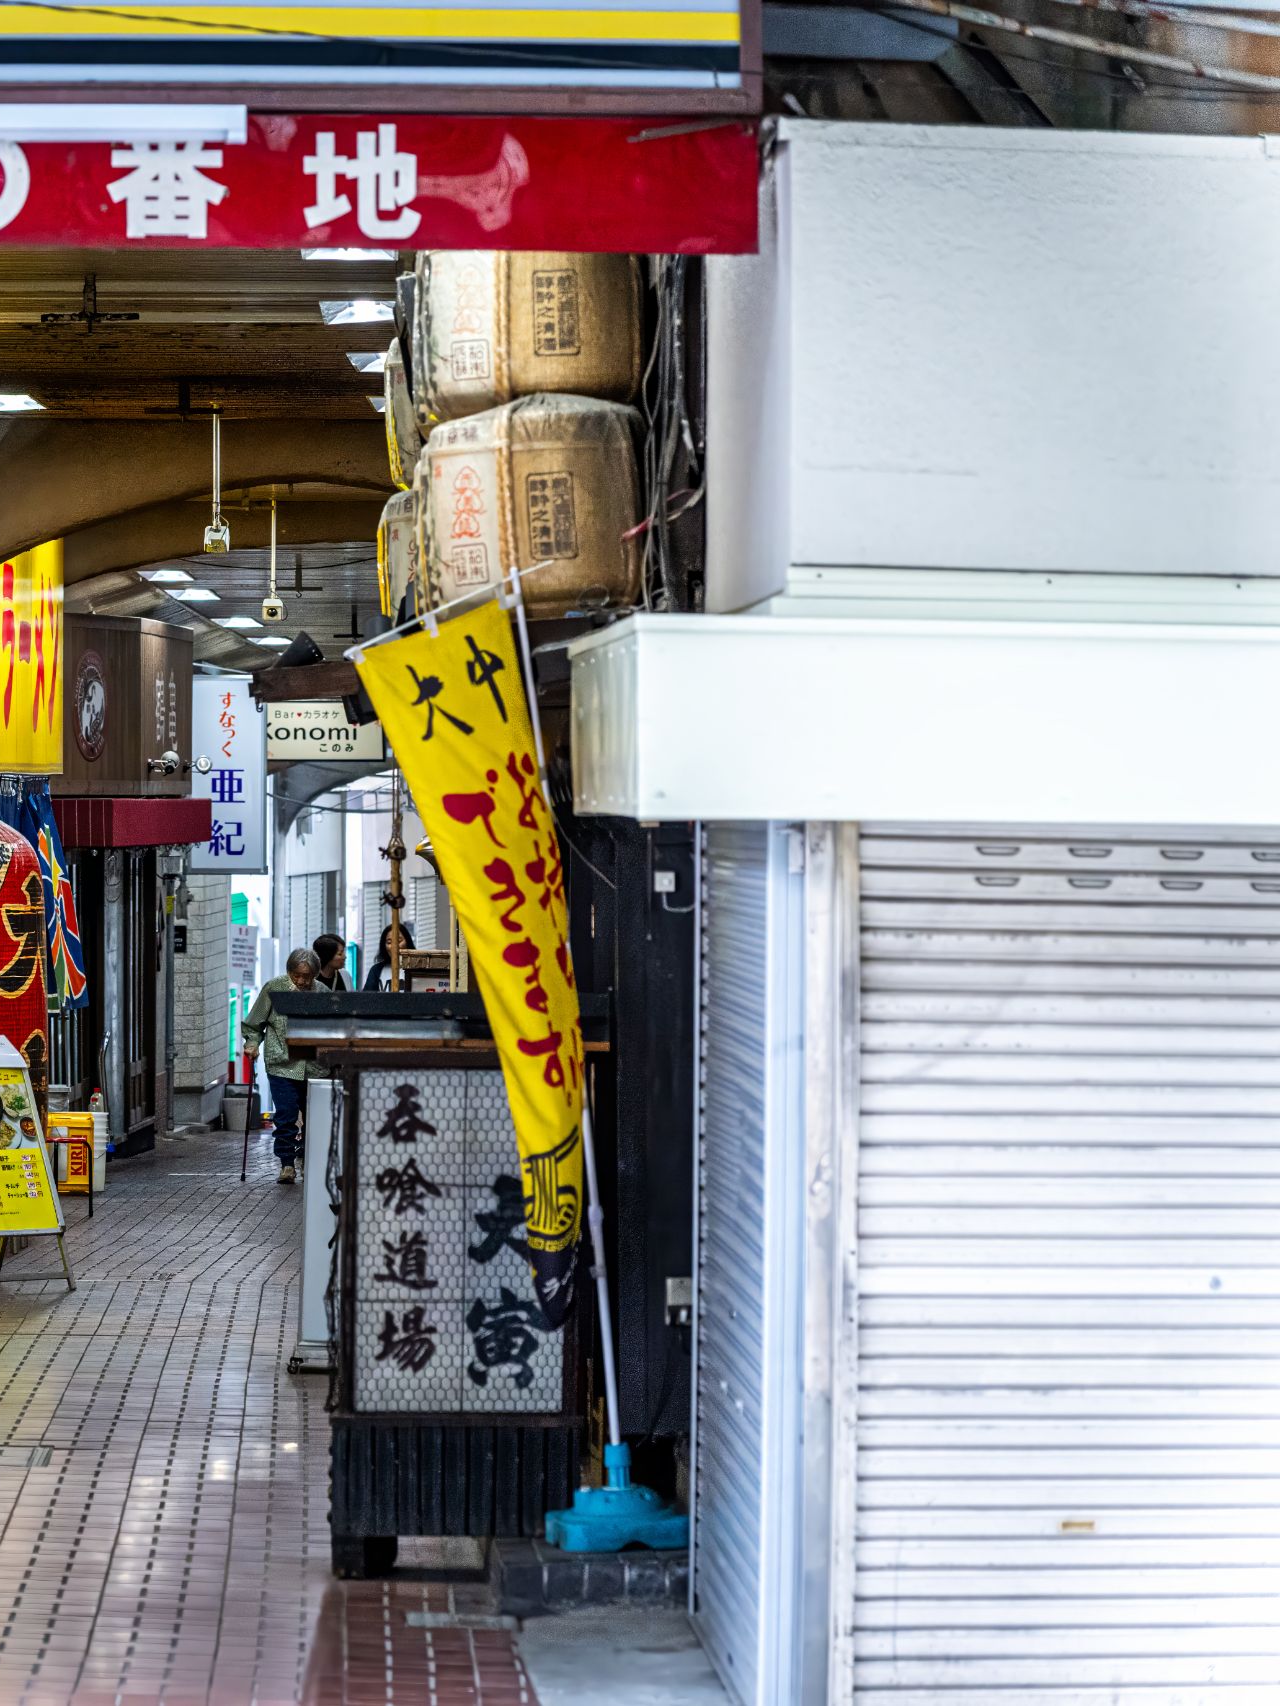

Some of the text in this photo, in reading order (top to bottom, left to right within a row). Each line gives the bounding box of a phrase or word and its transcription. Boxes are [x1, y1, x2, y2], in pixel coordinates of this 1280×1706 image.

[1, 562, 60, 736] ラーメン
[218, 691, 237, 758] すなっく
[319, 742, 354, 753] このみ
[208, 768, 247, 857] 亜紀
